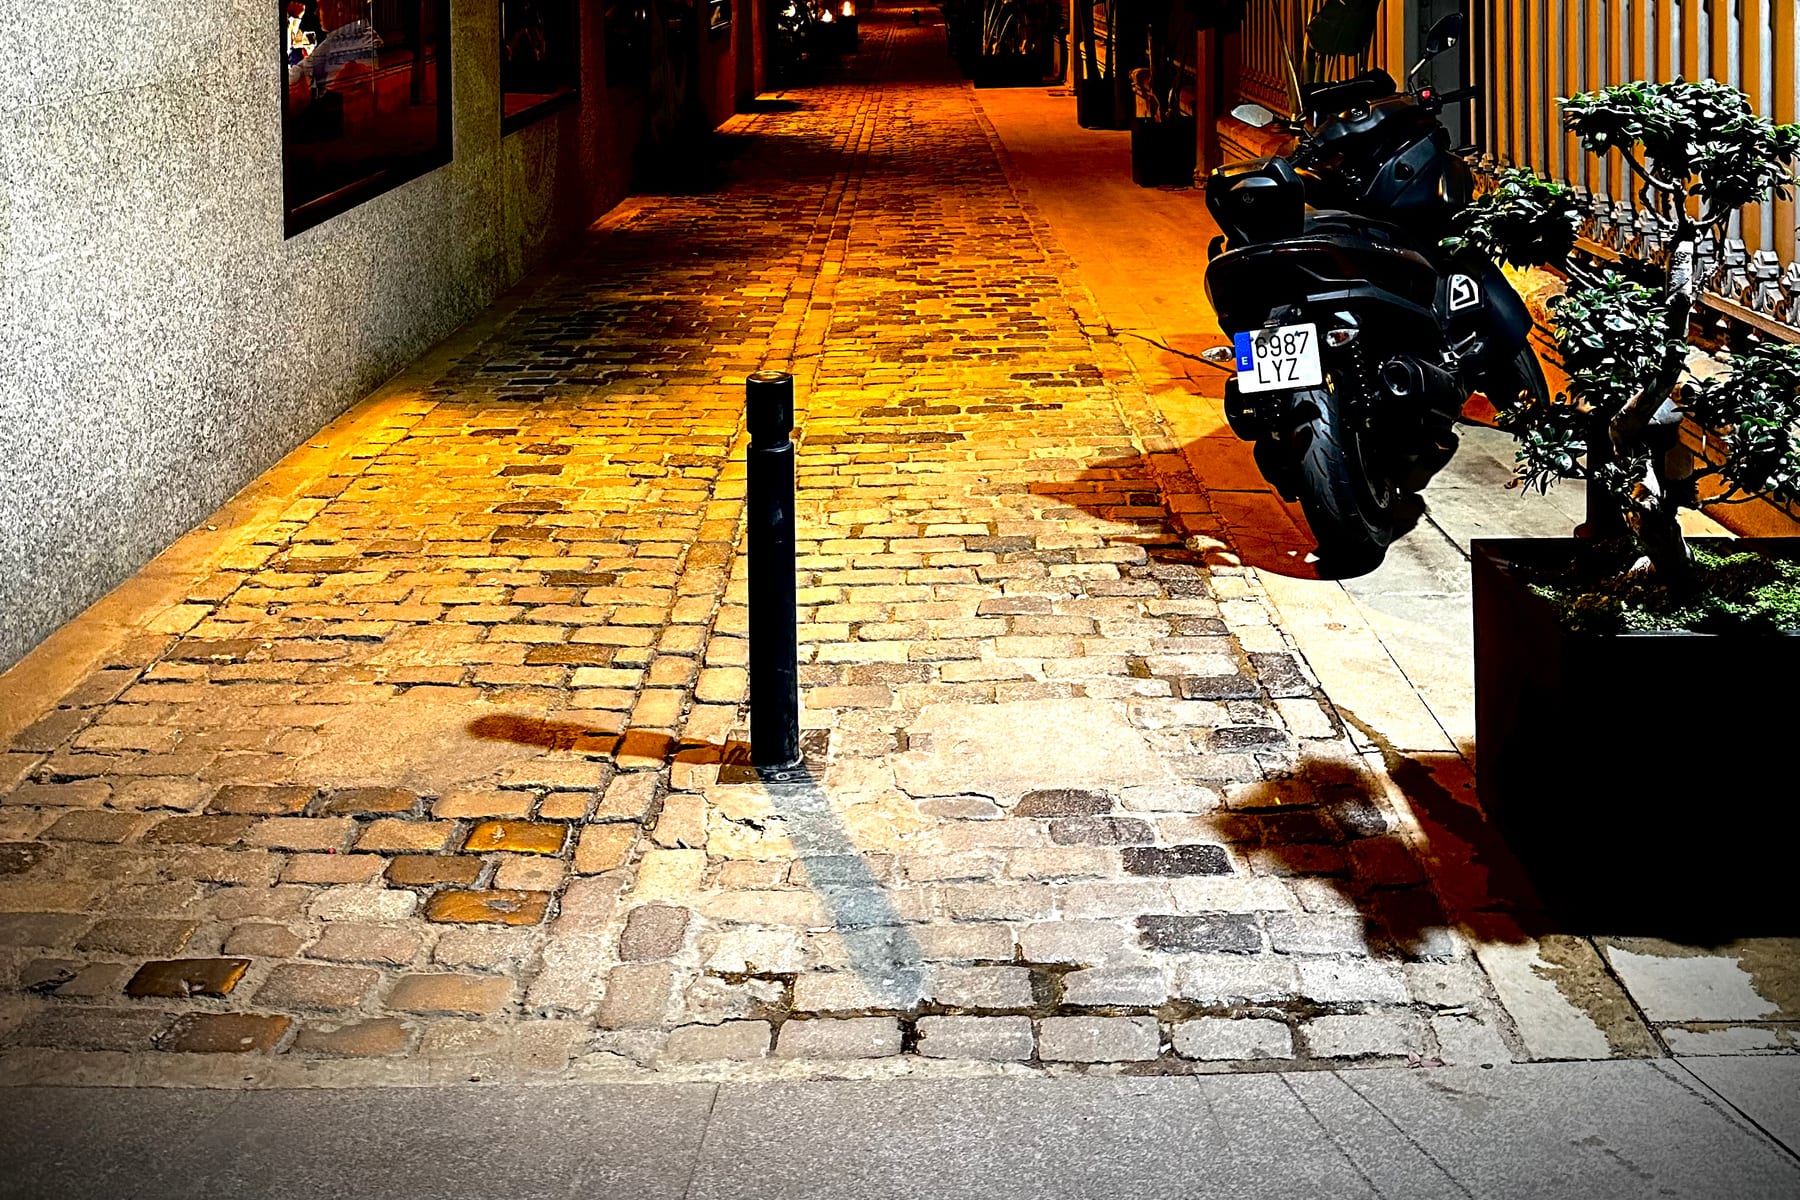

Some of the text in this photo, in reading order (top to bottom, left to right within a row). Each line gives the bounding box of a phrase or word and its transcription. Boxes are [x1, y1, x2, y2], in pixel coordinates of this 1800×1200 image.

[1254, 330, 1309, 358] 6987
[1241, 356, 1249, 366] E
[1257, 357, 1300, 385] LYZ
